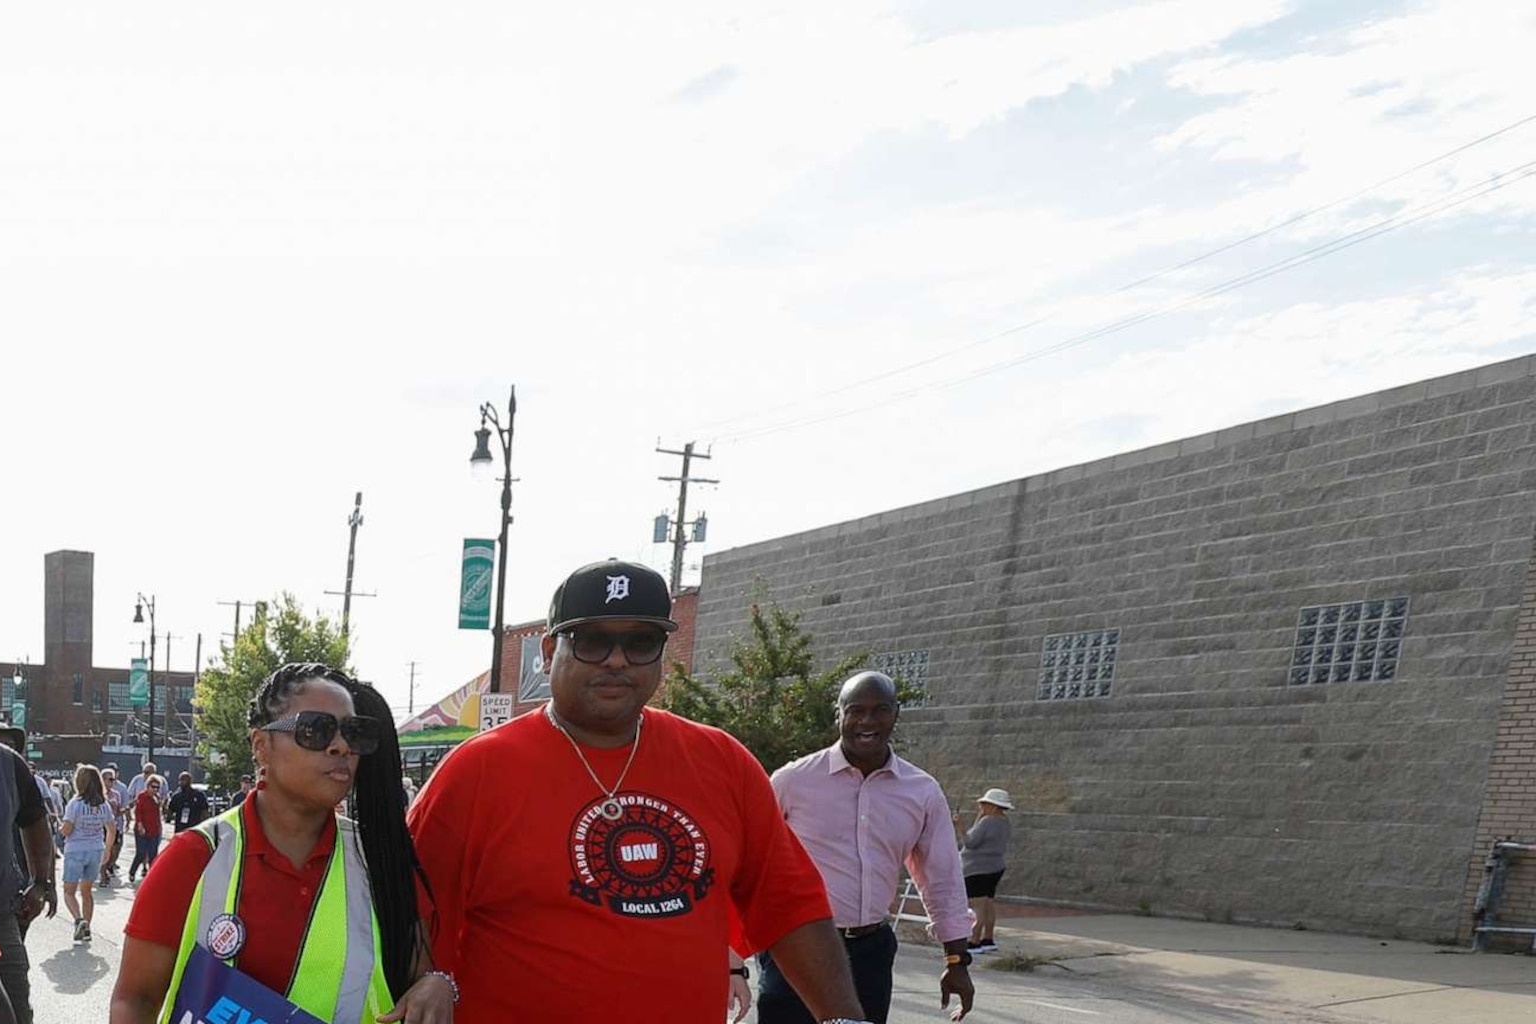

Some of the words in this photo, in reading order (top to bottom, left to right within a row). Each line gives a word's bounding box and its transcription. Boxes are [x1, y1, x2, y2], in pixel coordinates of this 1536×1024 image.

[483, 698, 511, 706] SPEED
[618, 795, 669, 812] RONGER
[575, 805, 602, 841] UNITED
[672, 810, 702, 838] THAN
[574, 844, 595, 884] LABOR
[621, 843, 658, 862] UAW
[693, 842, 706, 875] EVER
[622, 902, 660, 914] LOCAL
